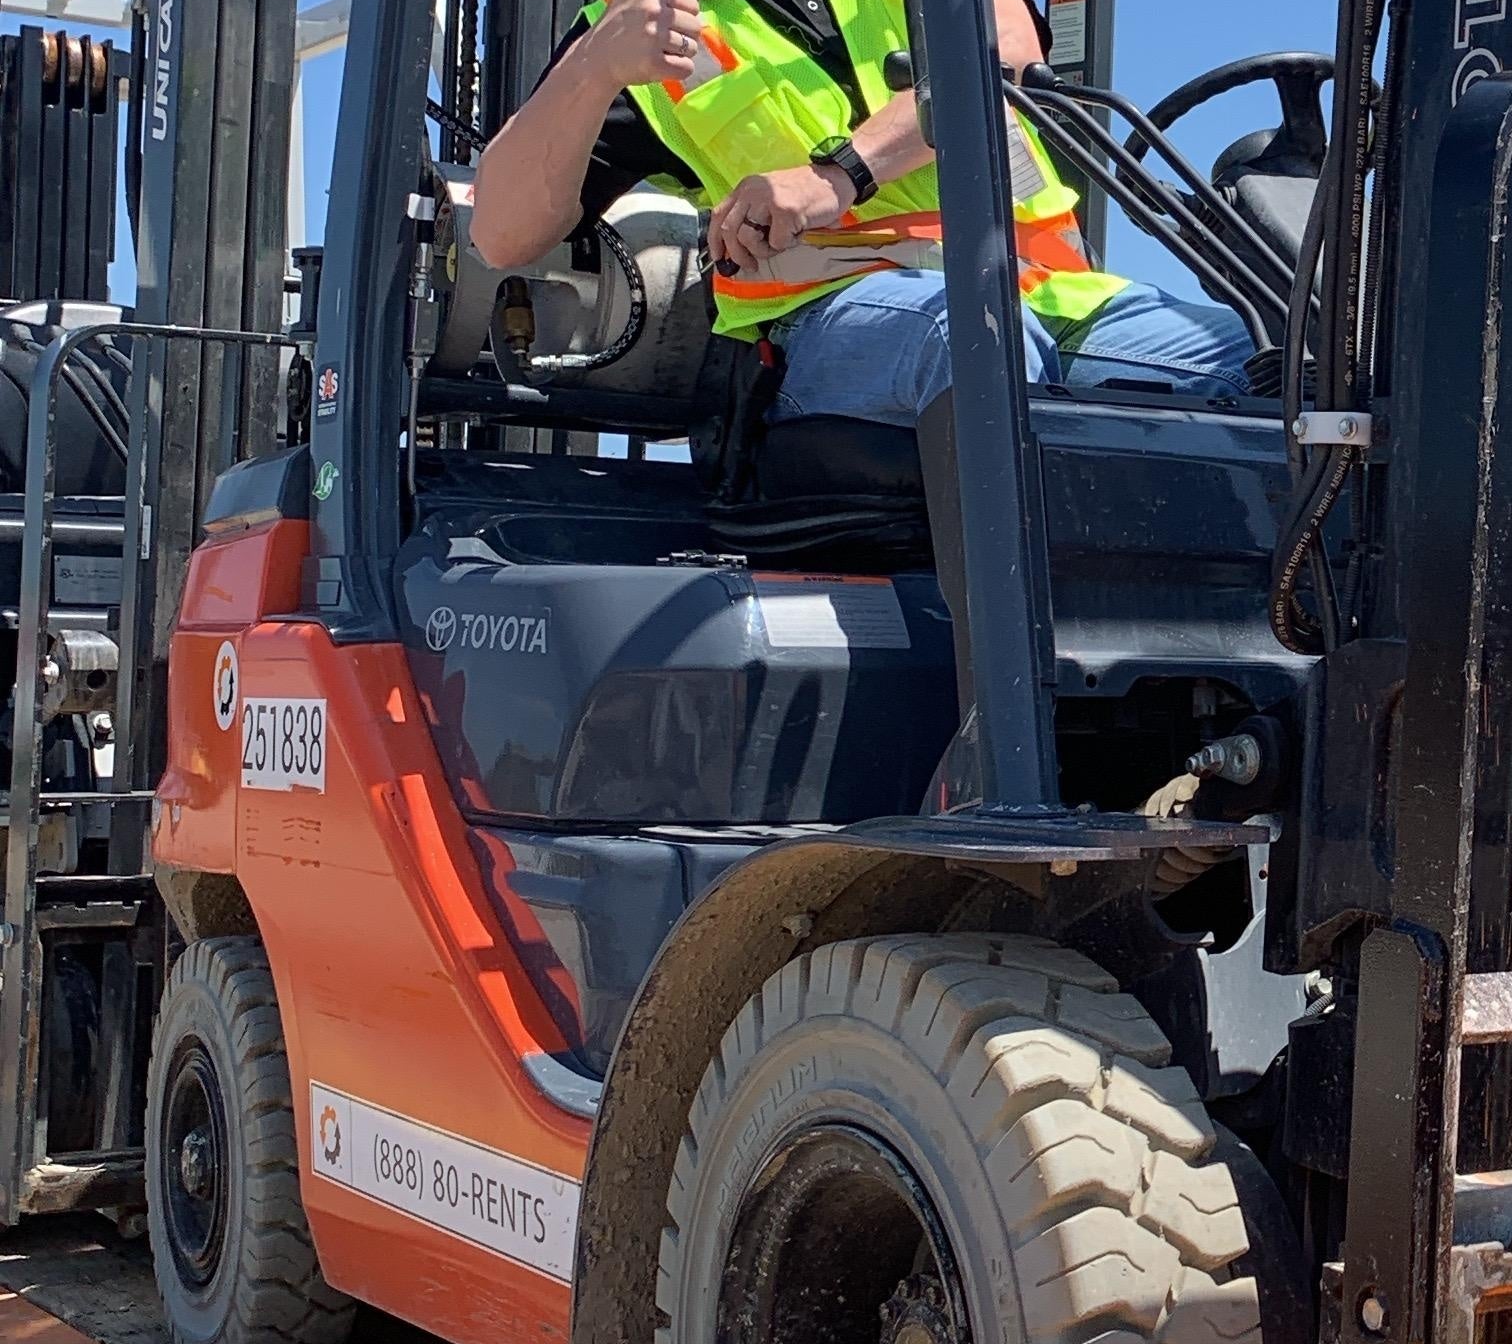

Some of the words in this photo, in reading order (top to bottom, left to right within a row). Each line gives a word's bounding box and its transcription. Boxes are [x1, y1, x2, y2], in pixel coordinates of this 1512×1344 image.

[460, 613, 547, 654] TOYOTA
[242, 703, 323, 776] 251838
[373, 1133, 424, 1200] (888)
[433, 1159, 546, 1244] 80-RENTS
